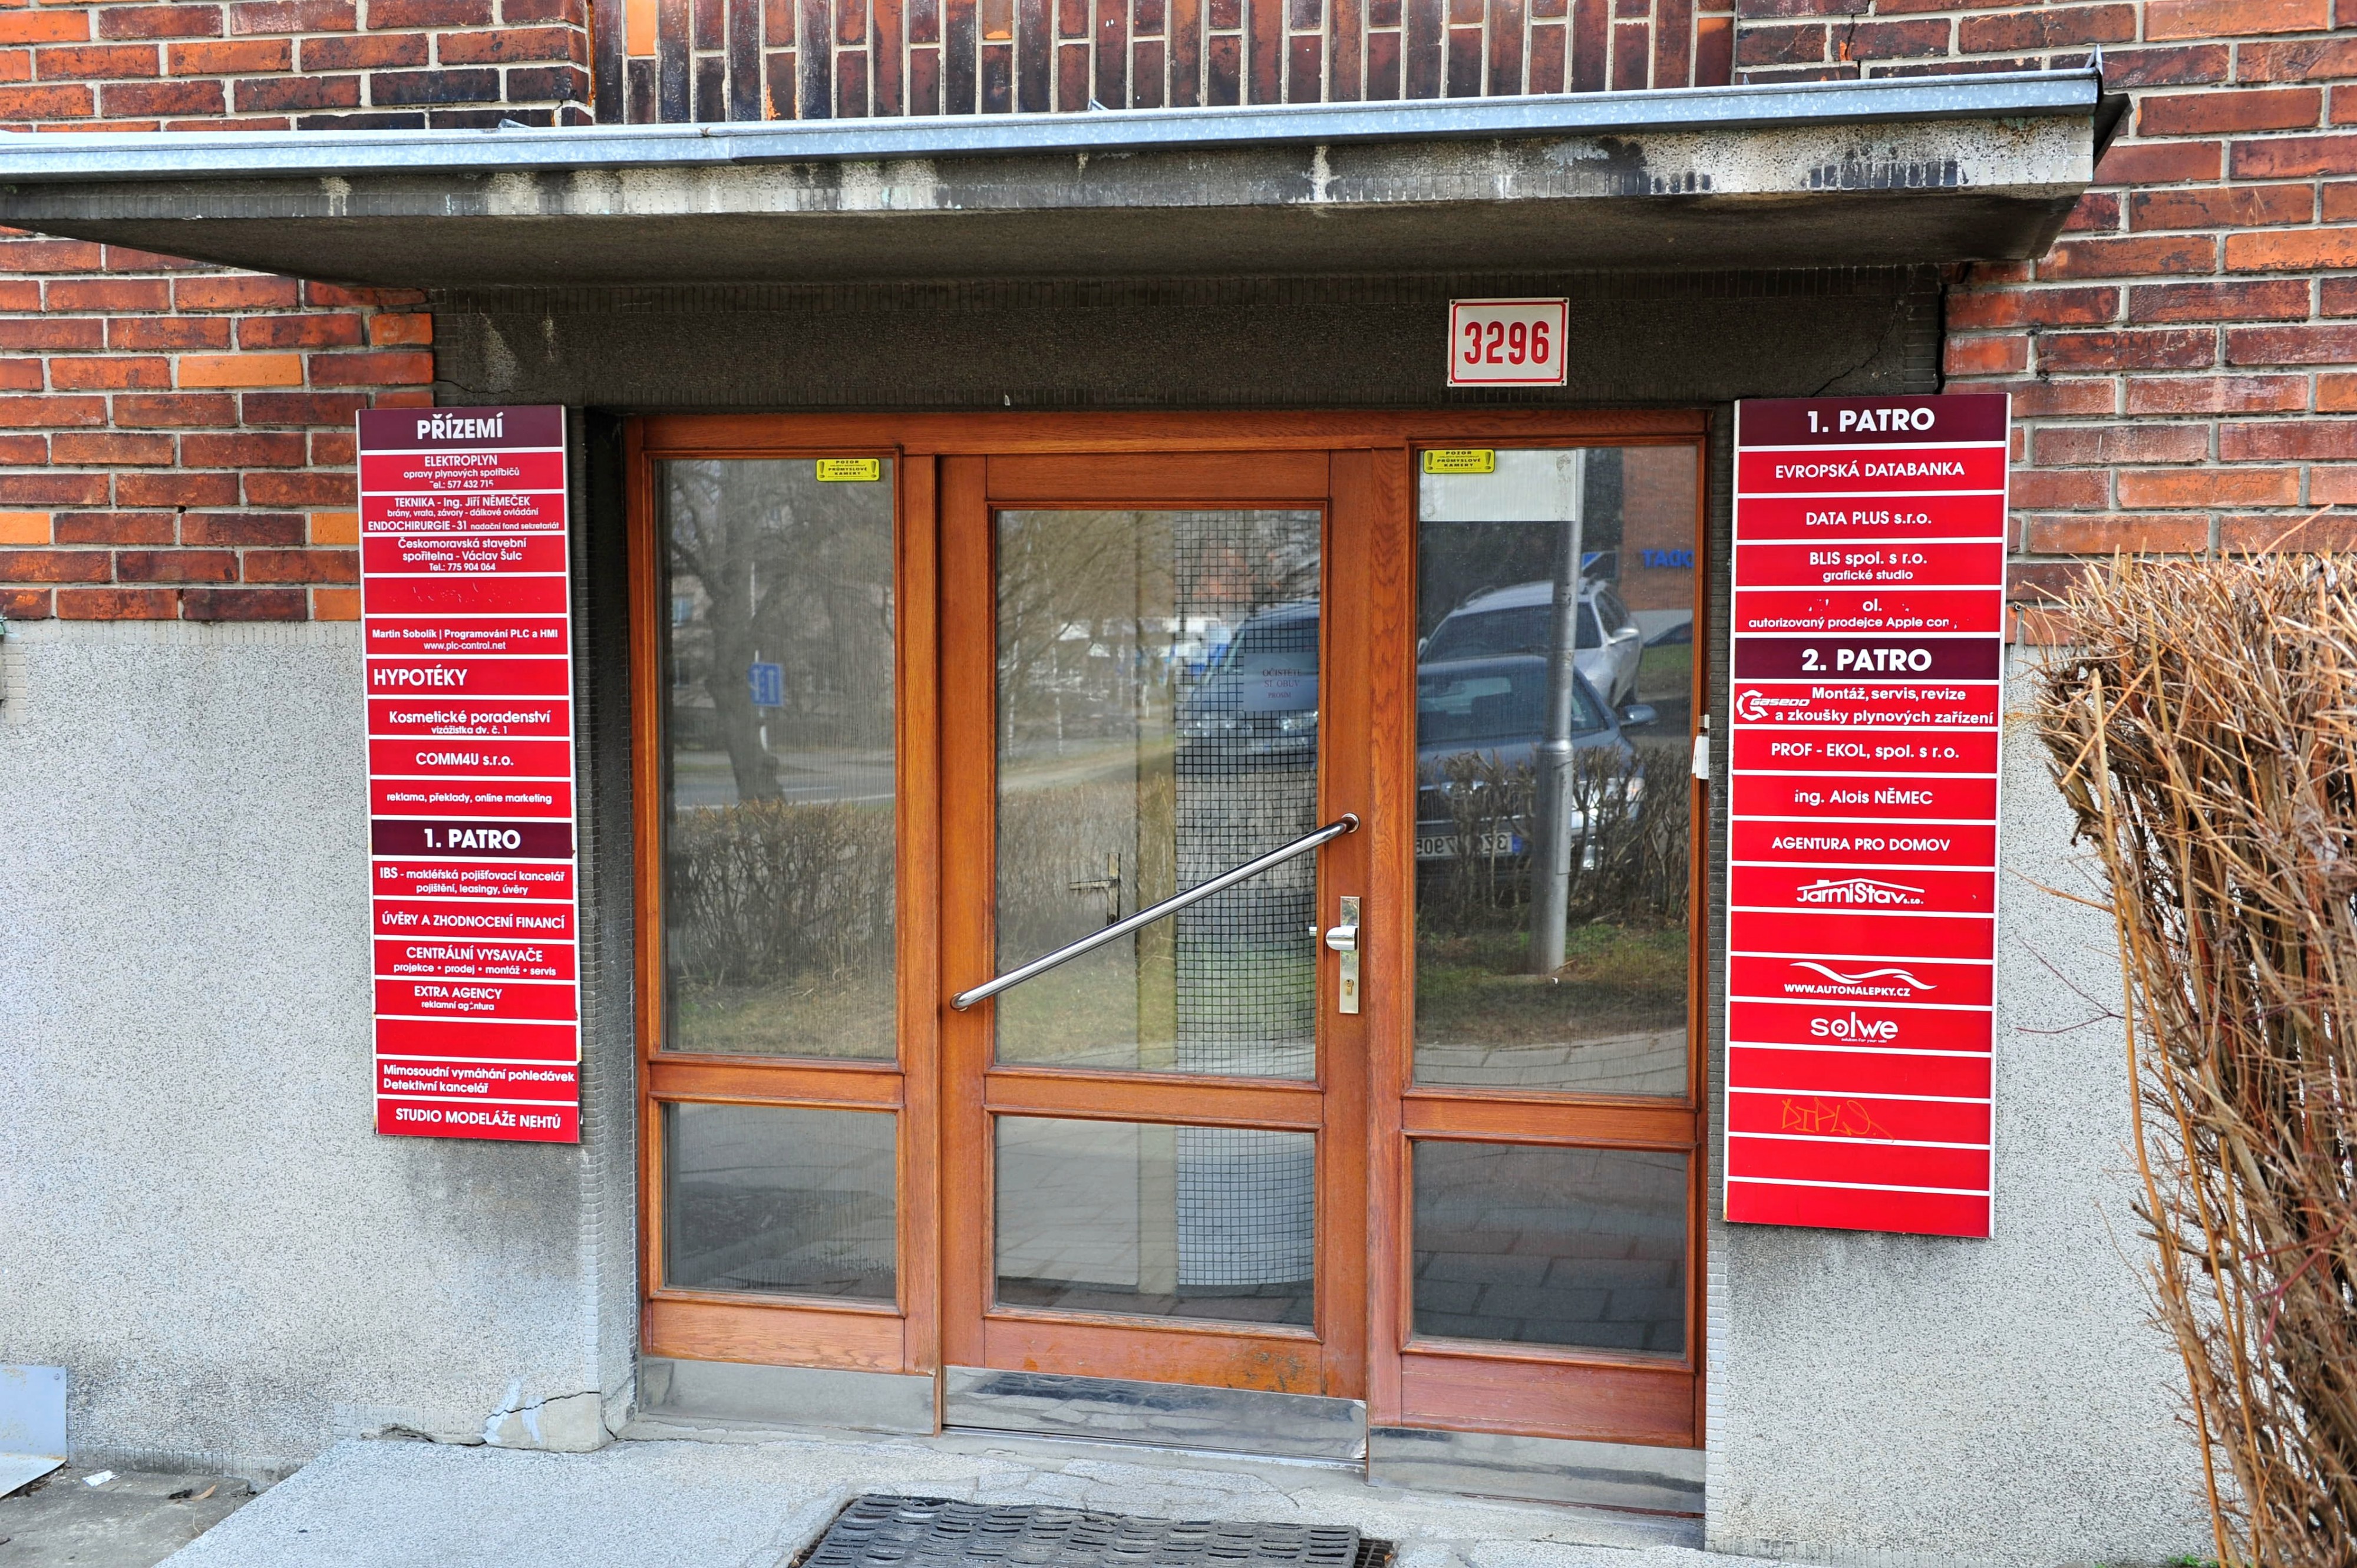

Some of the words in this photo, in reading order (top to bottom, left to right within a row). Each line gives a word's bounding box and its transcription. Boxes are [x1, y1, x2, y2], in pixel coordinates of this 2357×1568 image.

[1464, 321, 1549, 364] 3296
[418, 412, 503, 439] PŘÍZEMÍ
[1808, 411, 1828, 433] 1.
[1840, 408, 1935, 432] PATRO
[425, 455, 497, 467] ELEKTROPLYN
[435, 468, 478, 478] plynových
[1776, 460, 1860, 478] EVROPSKÁ
[1866, 462, 1965, 476] DATABANKA
[395, 498, 435, 507] TEKNIKA
[444, 498, 462, 509] Ing.
[466, 497, 480, 506] Jiří
[483, 494, 530, 506] NĚMEČEK
[388, 509, 411, 517] brány,
[438, 509, 463, 517] závory
[1807, 512, 1847, 525] DATA
[1853, 511, 1889, 524] PLUS
[1894, 514, 1931, 524] s.r.o.
[368, 521, 450, 530] ENDOCHIRURGIE
[457, 521, 466, 530] 31
[398, 537, 480, 548] Českomoravská
[483, 538, 526, 547] stavební
[403, 551, 453, 562] spořitelna
[462, 550, 498, 560] Václav
[501, 549, 522, 560] Šulc
[1810, 552, 1840, 565] BLIS
[1846, 552, 1884, 567] spol.
[1890, 554, 1897, 564] s
[1903, 554, 1927, 564] r.o.
[1823, 569, 1873, 582] grafické
[1876, 570, 1913, 579] studio
[1749, 617, 1824, 629] autorizovaný
[1828, 618, 1883, 629] prodejce
[1886, 618, 1923, 628] Apple
[403, 629, 437, 638] Sobolík
[445, 629, 508, 639] Programování
[511, 629, 529, 638] PLC
[424, 641, 506, 651] www.plc-control.net
[1803, 649, 1826, 670] 2.
[1837, 649, 1932, 671] PATRO
[374, 664, 467, 685] HYPOTÉKY
[1813, 687, 1869, 701] Montáž,
[1871, 687, 1919, 701] servis,
[1922, 688, 1966, 700] revize
[390, 710, 467, 723] Kosmetické
[471, 710, 550, 725] poradenství
[1775, 712, 1783, 720] a
[1788, 709, 1848, 724] zkoušky
[1854, 710, 1930, 725] plynových
[1935, 711, 1993, 724] zařízení
[416, 752, 478, 765] COMM4U
[483, 756, 513, 765] s.r.o.
[1772, 743, 1812, 756] PROF
[1827, 744, 1870, 758] EKOL,
[1876, 745, 1914, 760] spol.
[1920, 748, 1927, 757] s
[387, 793, 427, 802] reklama,
[430, 793, 472, 803] překlady,
[475, 794, 503, 802] online
[506, 794, 552, 804] marketing
[1795, 790, 1824, 806] ing.
[1830, 790, 1869, 803] Alois
[1875, 788, 1932, 804] NĚMEC
[424, 828, 441, 847] 1.
[449, 829, 520, 849] PATRO
[1772, 837, 1850, 849] AGENTURA
[1855, 839, 1884, 850] PRO
[1890, 839, 1950, 851] DOMOV
[381, 867, 398, 878] IBS
[407, 869, 458, 879] makléřská
[461, 870, 516, 881] pojišťovací
[519, 872, 565, 881] kancelář
[417, 884, 457, 893] pojištění,
[460, 884, 500, 895] leasingy,
[503, 884, 528, 895] úvěry
[1797, 883, 1906, 903] JarmiStav
[382, 911, 418, 925] ÚVĚRY
[421, 915, 430, 925] A
[434, 914, 513, 927] ZHODNOCENÍ
[516, 915, 565, 928] FINANCÍ
[407, 945, 474, 959] CENTRÁLNÍ
[477, 948, 542, 962] VYSAVAČE
[394, 963, 434, 973] projekce
[445, 965, 474, 975] prodej
[486, 965, 520, 974] montáž
[415, 986, 448, 997] EXTRA
[452, 988, 502, 999] AGENCY
[1784, 984, 1910, 996] WWW.AUTONALEPKY.CZ
[1811, 1011, 1898, 1039] solwe
[384, 1065, 449, 1077] Mimosoudní
[451, 1068, 506, 1080] vymáhání
[509, 1070, 575, 1081] pohledávek
[384, 1078, 437, 1091] Detektivní
[440, 1082, 488, 1093] kancelář
[396, 1108, 441, 1122] STUDIO
[446, 1110, 516, 1126] MODELÁŽE
[520, 1114, 560, 1128] NEHTŮ
